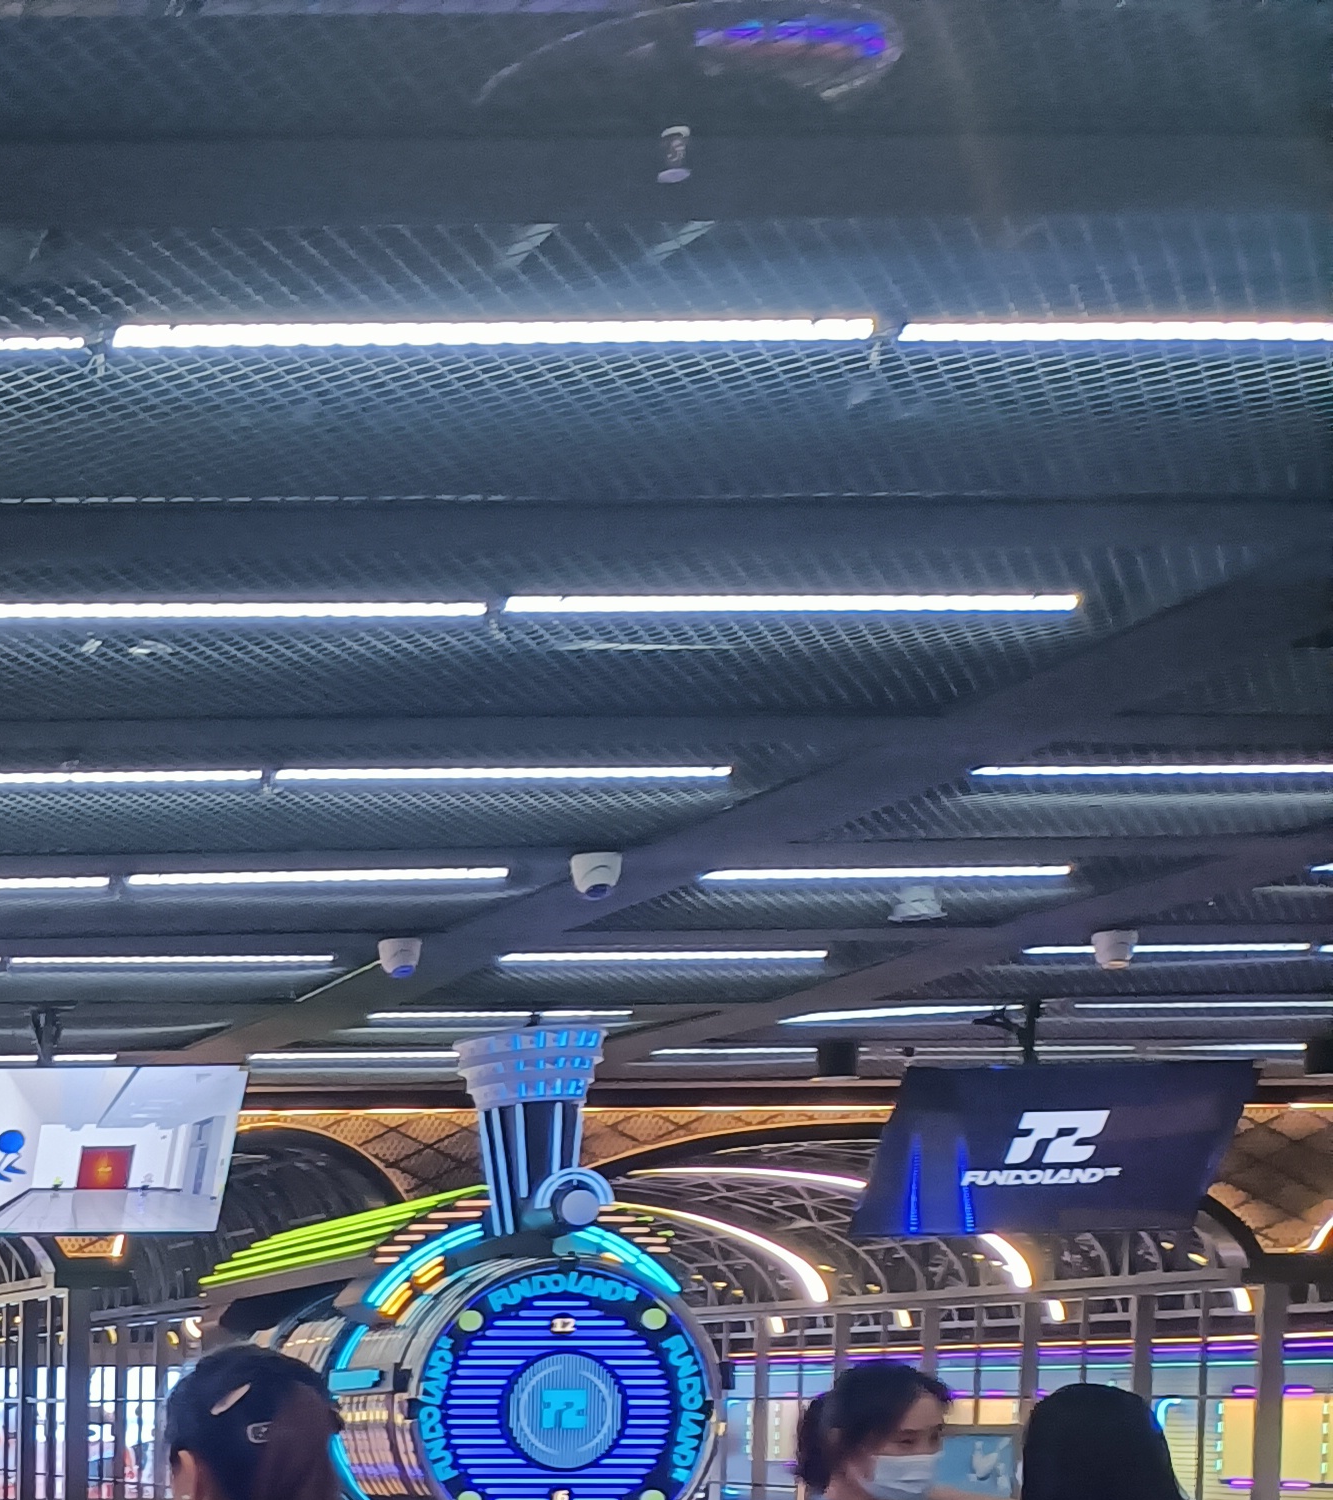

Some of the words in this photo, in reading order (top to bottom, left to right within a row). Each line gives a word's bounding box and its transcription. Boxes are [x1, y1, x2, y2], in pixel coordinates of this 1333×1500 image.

[961, 1168, 1106, 1186] FUNDOLAND
[487, 1271, 629, 1312] FUNDOLAND
[418, 1350, 459, 1482] FUNDOLAND
[661, 1334, 705, 1467] FUNDOLAND
